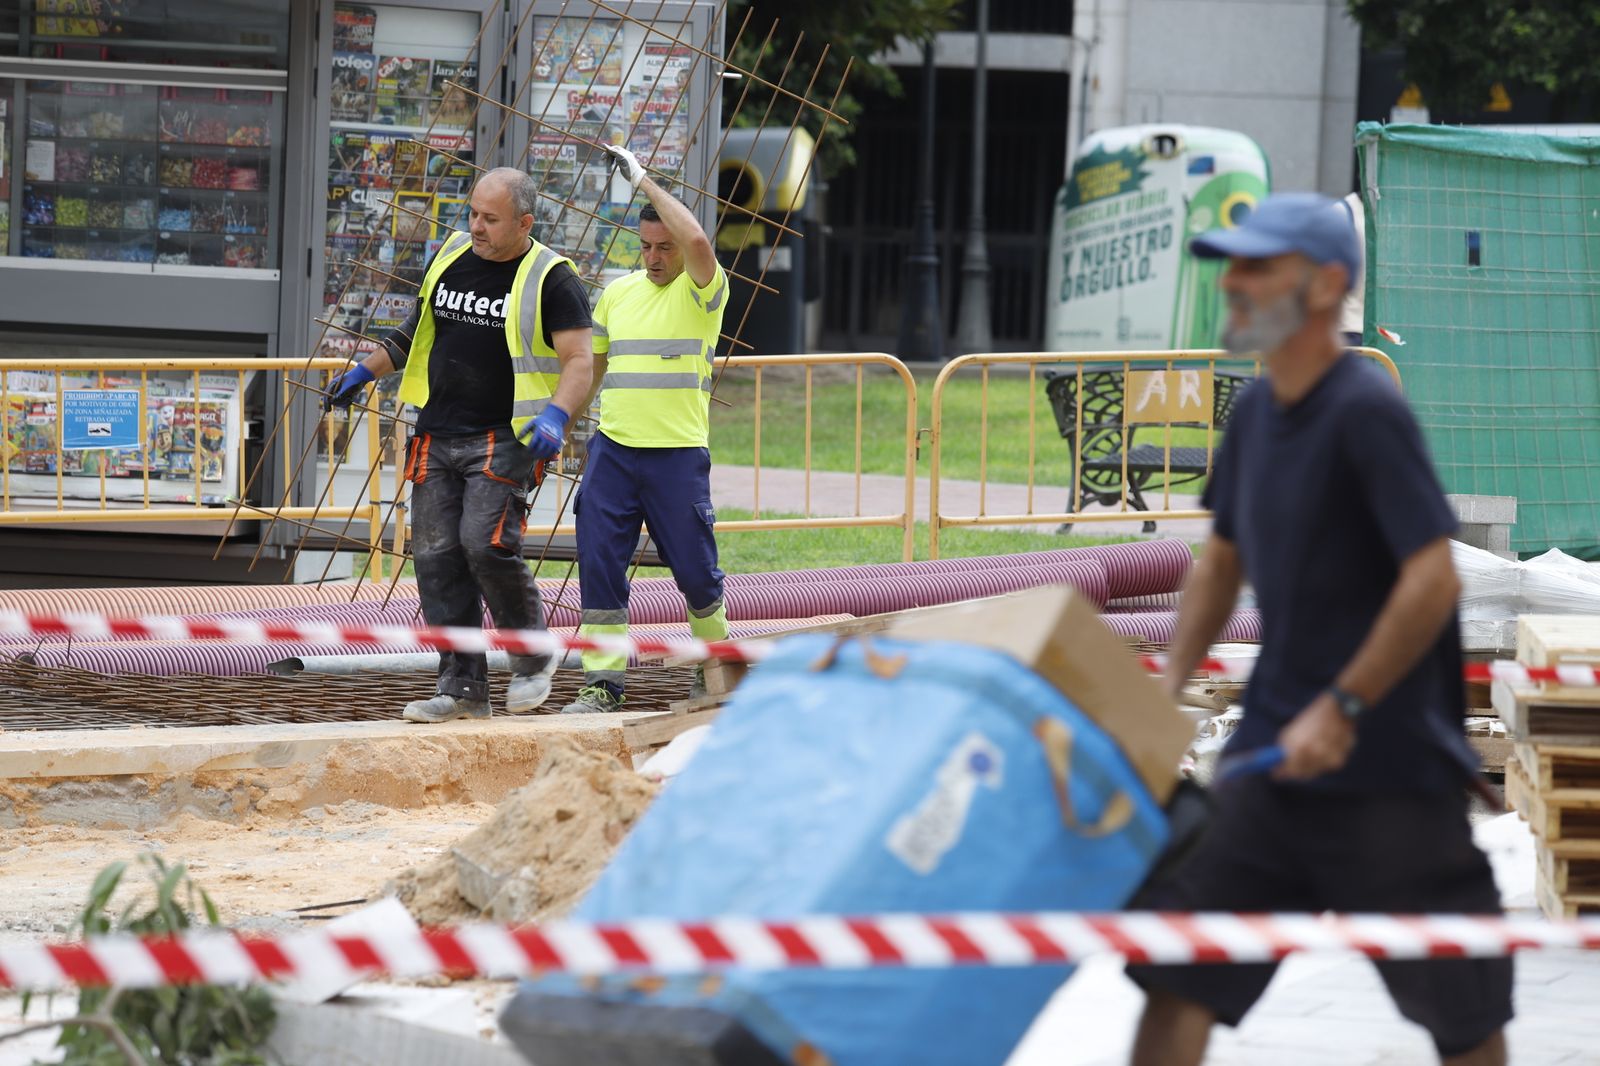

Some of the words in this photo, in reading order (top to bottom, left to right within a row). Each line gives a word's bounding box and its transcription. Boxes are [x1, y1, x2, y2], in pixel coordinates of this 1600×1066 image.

[429, 137, 455, 148] muy
[560, 148, 575, 160] Up
[1062, 250, 1074, 274] Y
[1080, 223, 1173, 271] NUESTRO
[1060, 255, 1157, 303] ORGULLO.
[64, 392, 103, 400] PROHIBIDO
